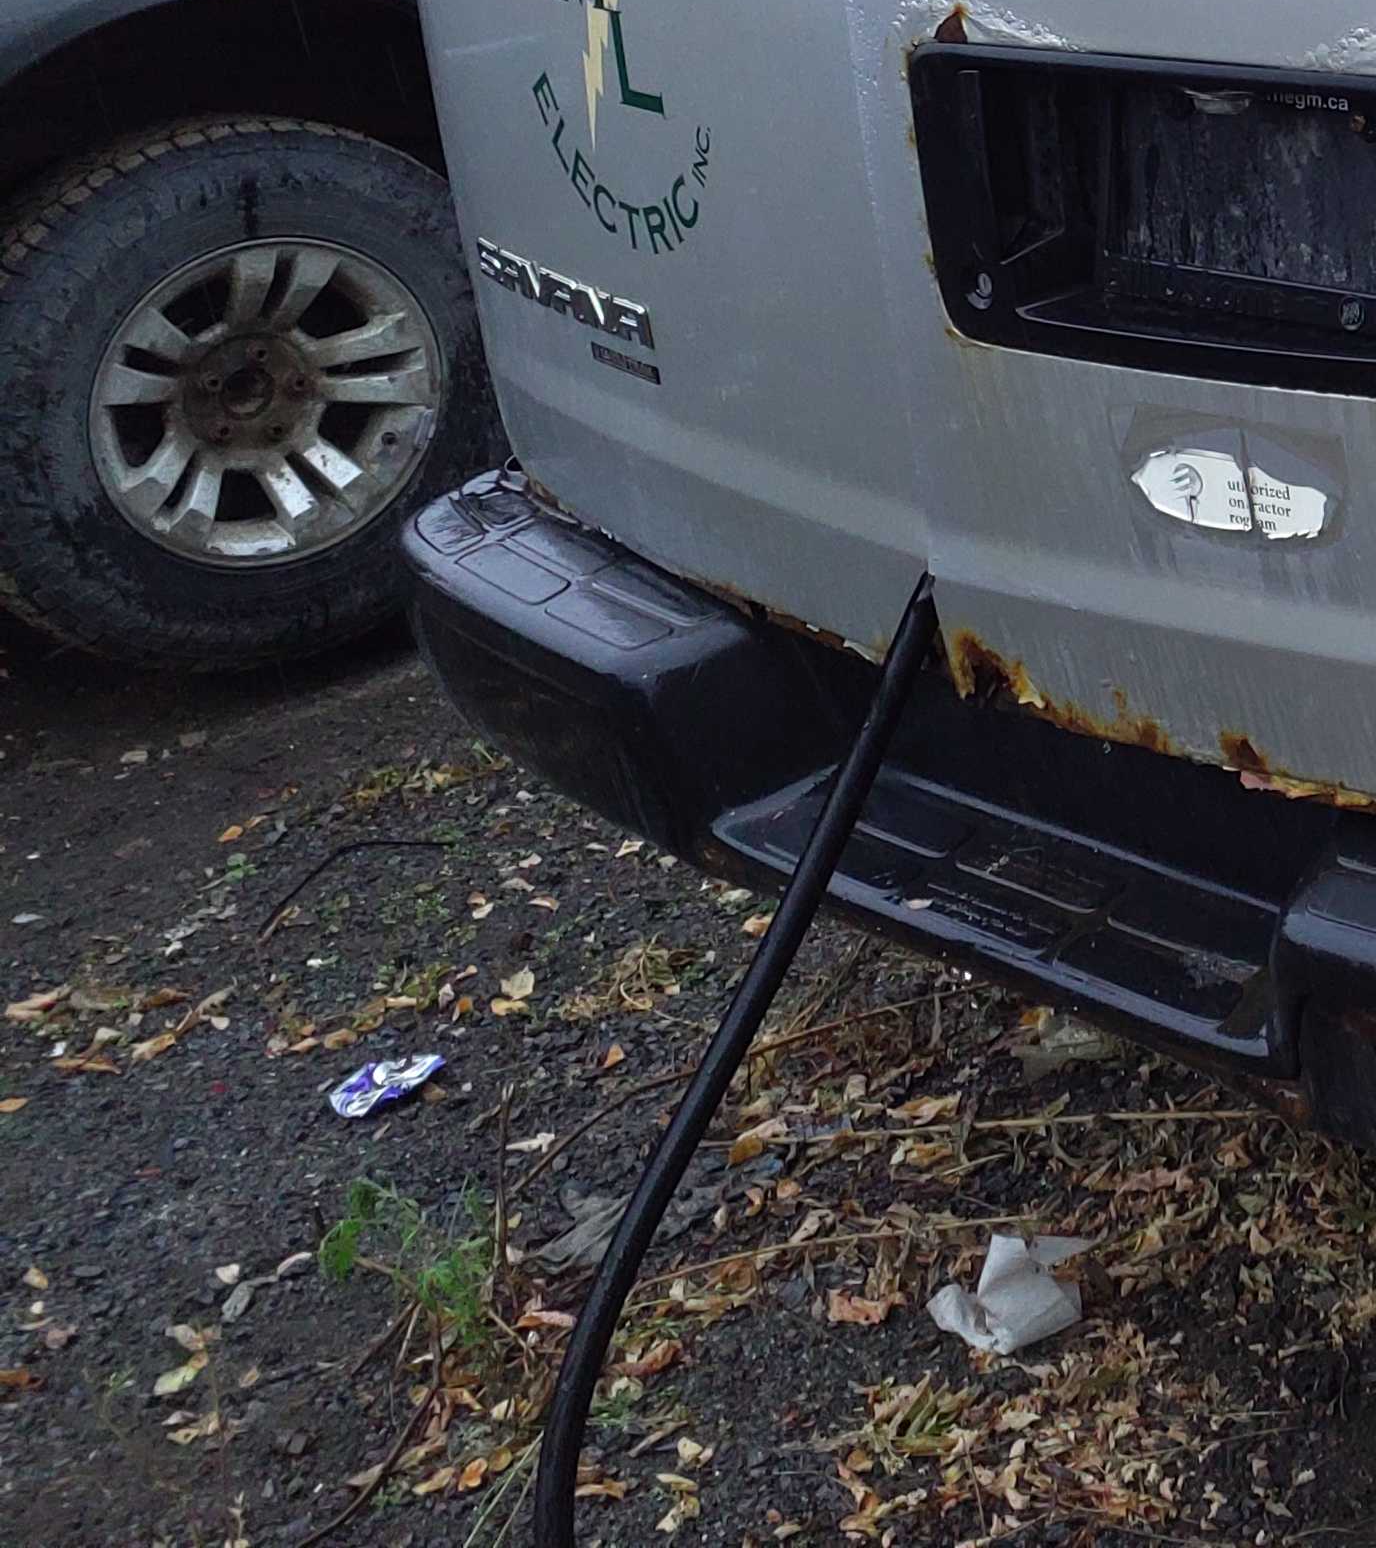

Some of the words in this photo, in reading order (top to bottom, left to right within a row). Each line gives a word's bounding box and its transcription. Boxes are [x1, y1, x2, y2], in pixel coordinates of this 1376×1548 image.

[531, 70, 701, 255] ELECTRIC
[1226, 480, 1291, 502] utorized
[1228, 496, 1292, 518] onractor
